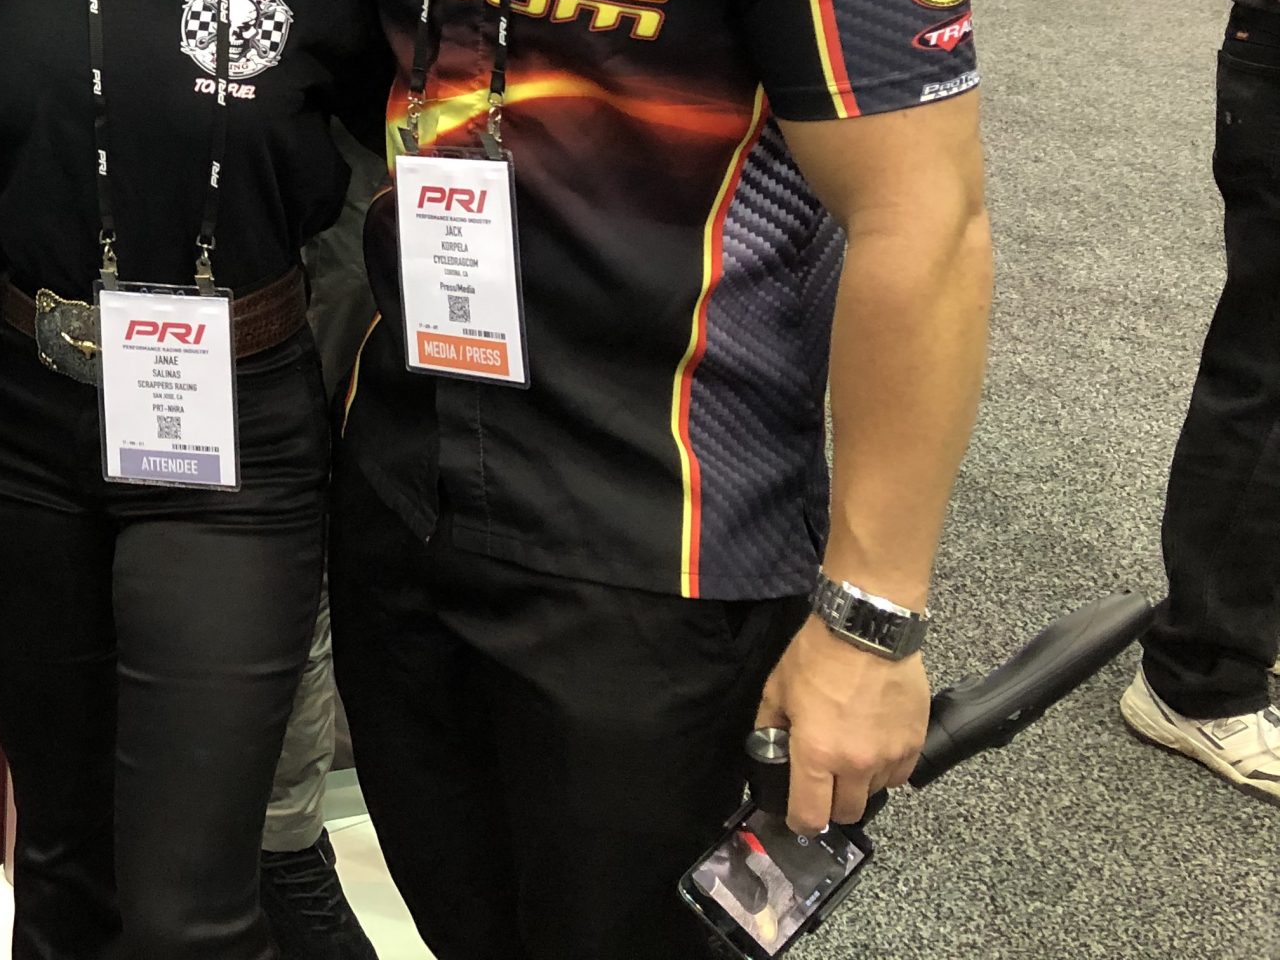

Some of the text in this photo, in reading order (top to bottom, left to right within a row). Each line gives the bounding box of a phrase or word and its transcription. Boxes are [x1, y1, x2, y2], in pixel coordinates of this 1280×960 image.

[499, 16, 507, 46] PRI
[92, 68, 101, 95] PRI
[194, 77, 216, 94] TO
[217, 78, 227, 106] PRI
[98, 149, 107, 175] PRI
[211, 161, 221, 188] PRI
[417, 185, 487, 214] PRI
[445, 225, 463, 237] JACK
[125, 320, 206, 345] PRI
[153, 355, 179, 366] JANAE
[424, 339, 501, 367] MEDIA / PRESS
[137, 379, 198, 392] SCRAPPERS RACING
[152, 368, 181, 379] SALINAS
[141, 456, 198, 475] ATTENDEE
